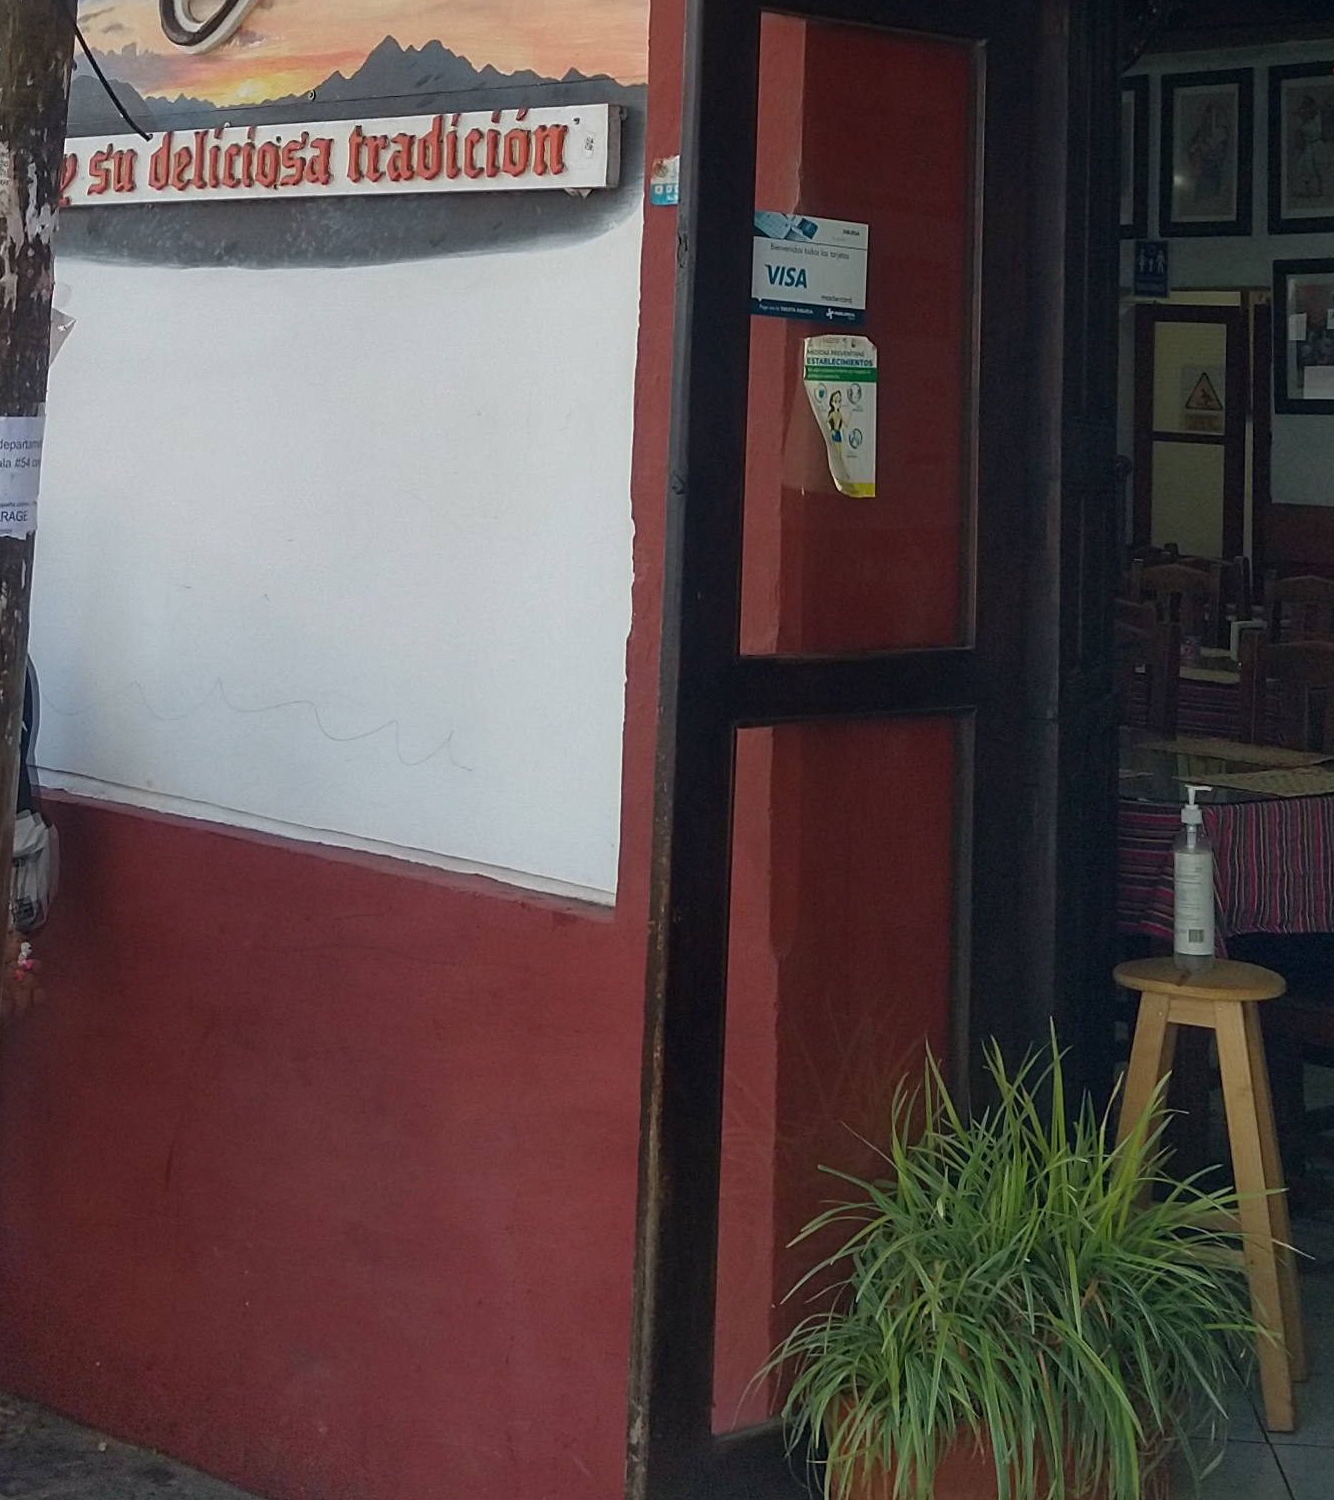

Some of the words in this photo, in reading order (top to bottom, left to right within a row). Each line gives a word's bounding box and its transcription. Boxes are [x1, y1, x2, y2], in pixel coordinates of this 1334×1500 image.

[87, 143, 138, 195] su
[148, 127, 334, 190] deliciosa
[347, 107, 569, 184] tradición
[764, 264, 808, 289] VISA
